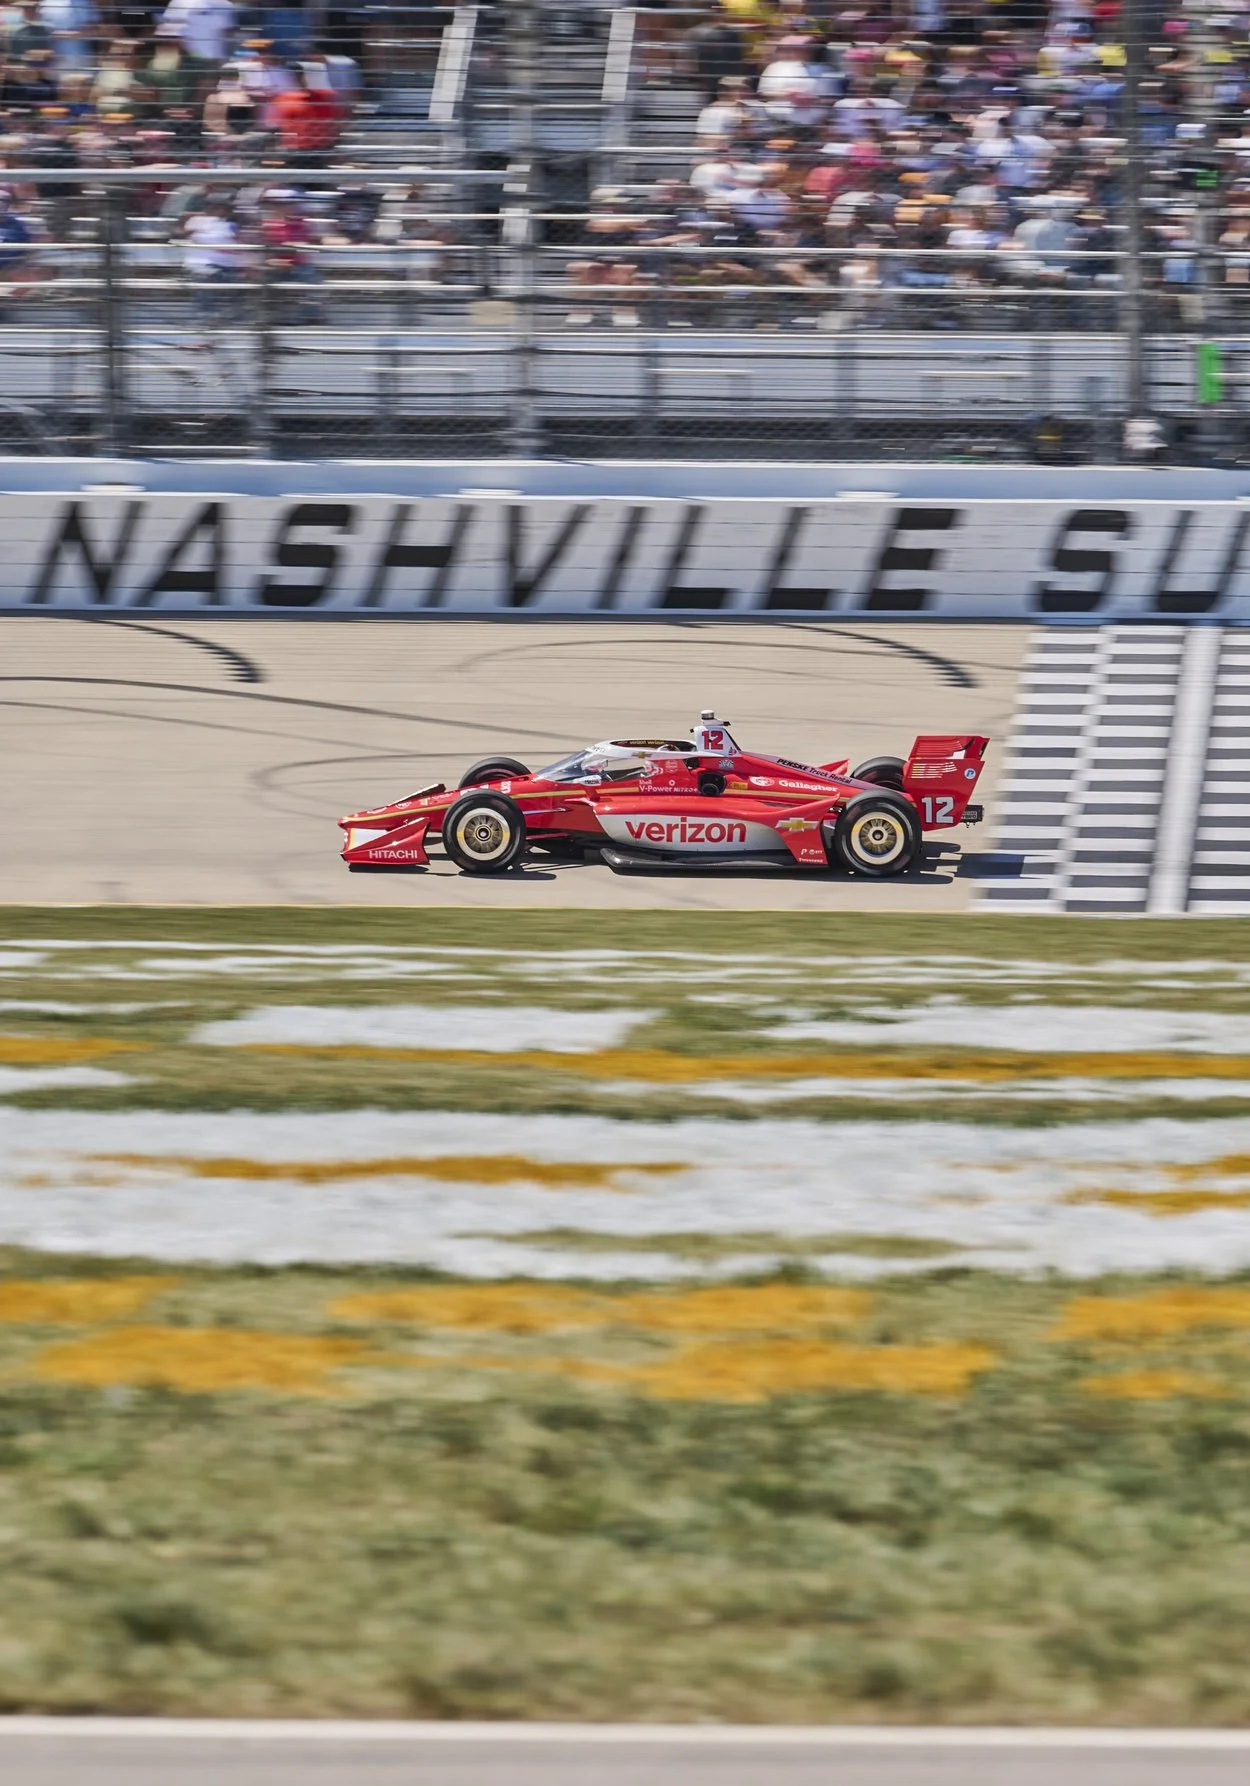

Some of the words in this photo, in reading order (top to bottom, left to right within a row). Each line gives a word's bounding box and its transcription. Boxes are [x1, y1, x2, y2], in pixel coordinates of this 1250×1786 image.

[29, 500, 967, 612] NASHVILLE
[702, 730, 724, 750] 12
[776, 758, 808, 772] PENSKE
[808, 767, 829, 778] Truck
[829, 773, 852, 785] Rental
[639, 784, 672, 792] V-Power
[779, 779, 838, 791] Gallagher
[921, 796, 954, 824] 12
[625, 816, 747, 843] verizon
[369, 850, 418, 859] HITACHI
